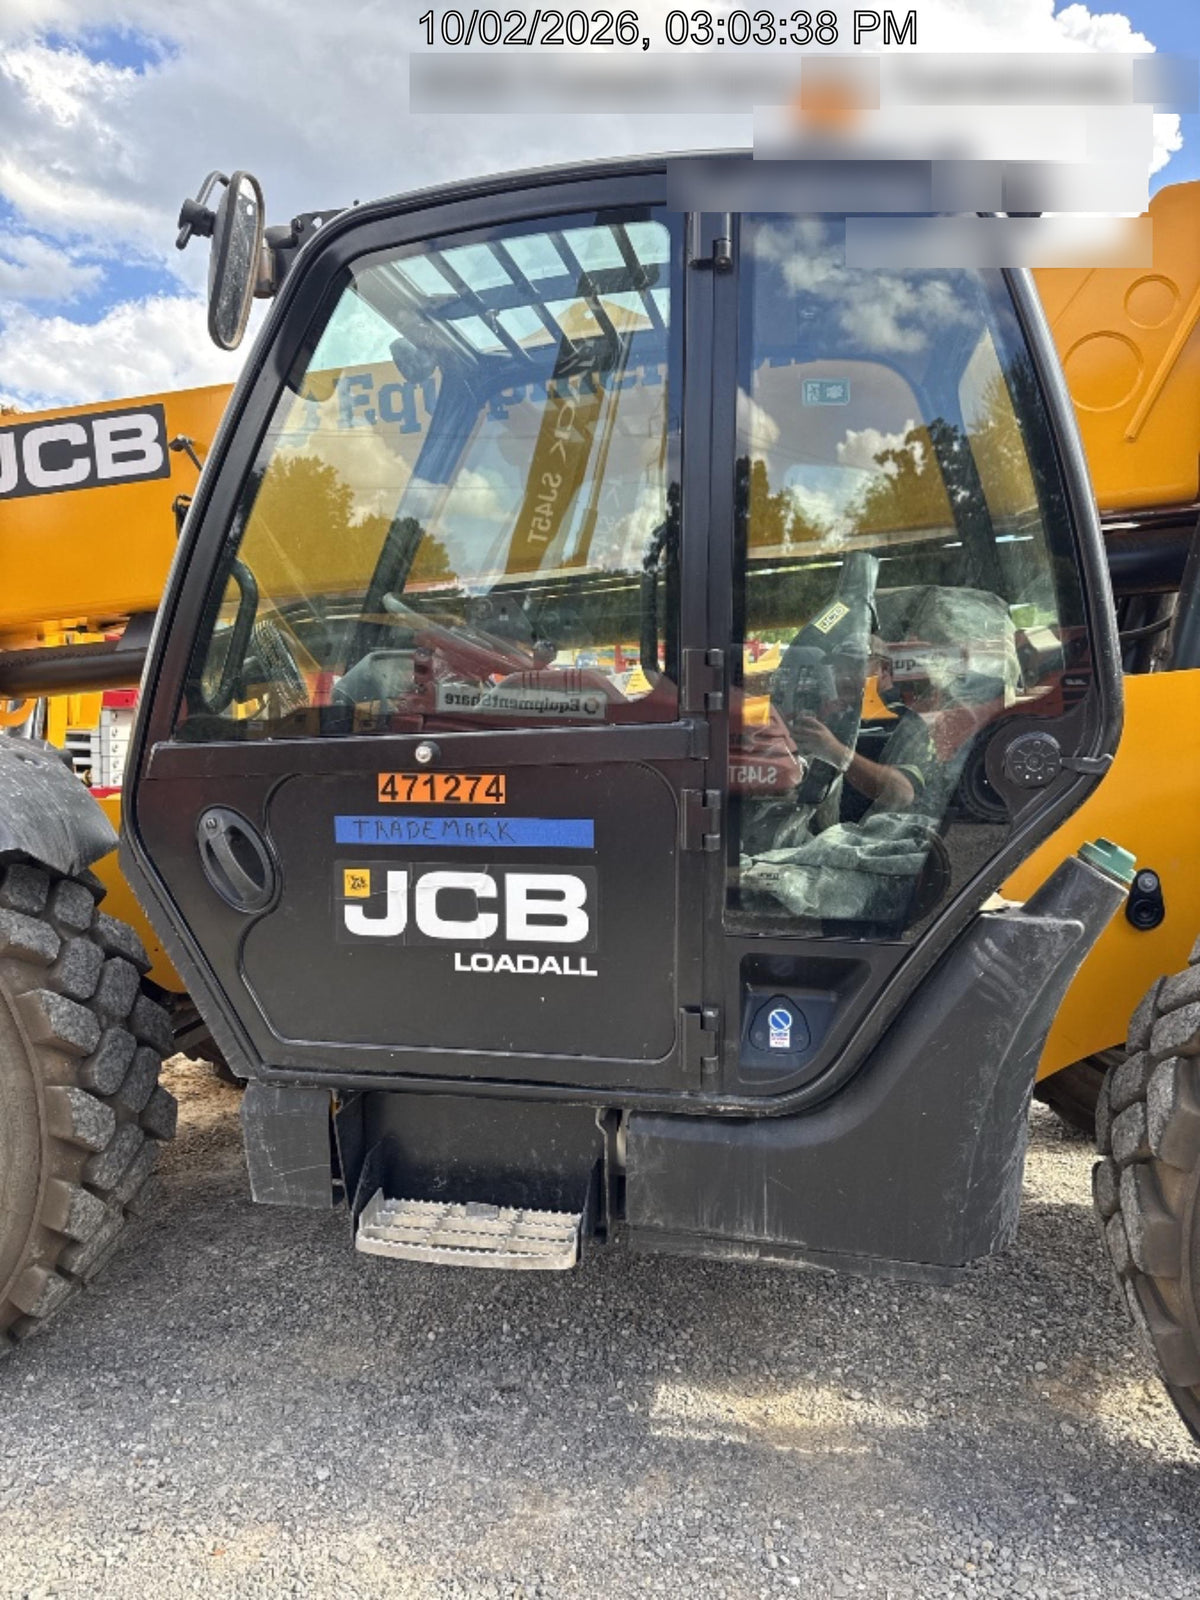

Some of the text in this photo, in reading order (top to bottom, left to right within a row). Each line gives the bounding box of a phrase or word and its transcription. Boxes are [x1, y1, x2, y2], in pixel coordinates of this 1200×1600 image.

[380, 774, 503, 803] 471274
[353, 820, 516, 843] TRADEMARK
[344, 870, 589, 942] JCB
[454, 952, 598, 976] LOADALL
